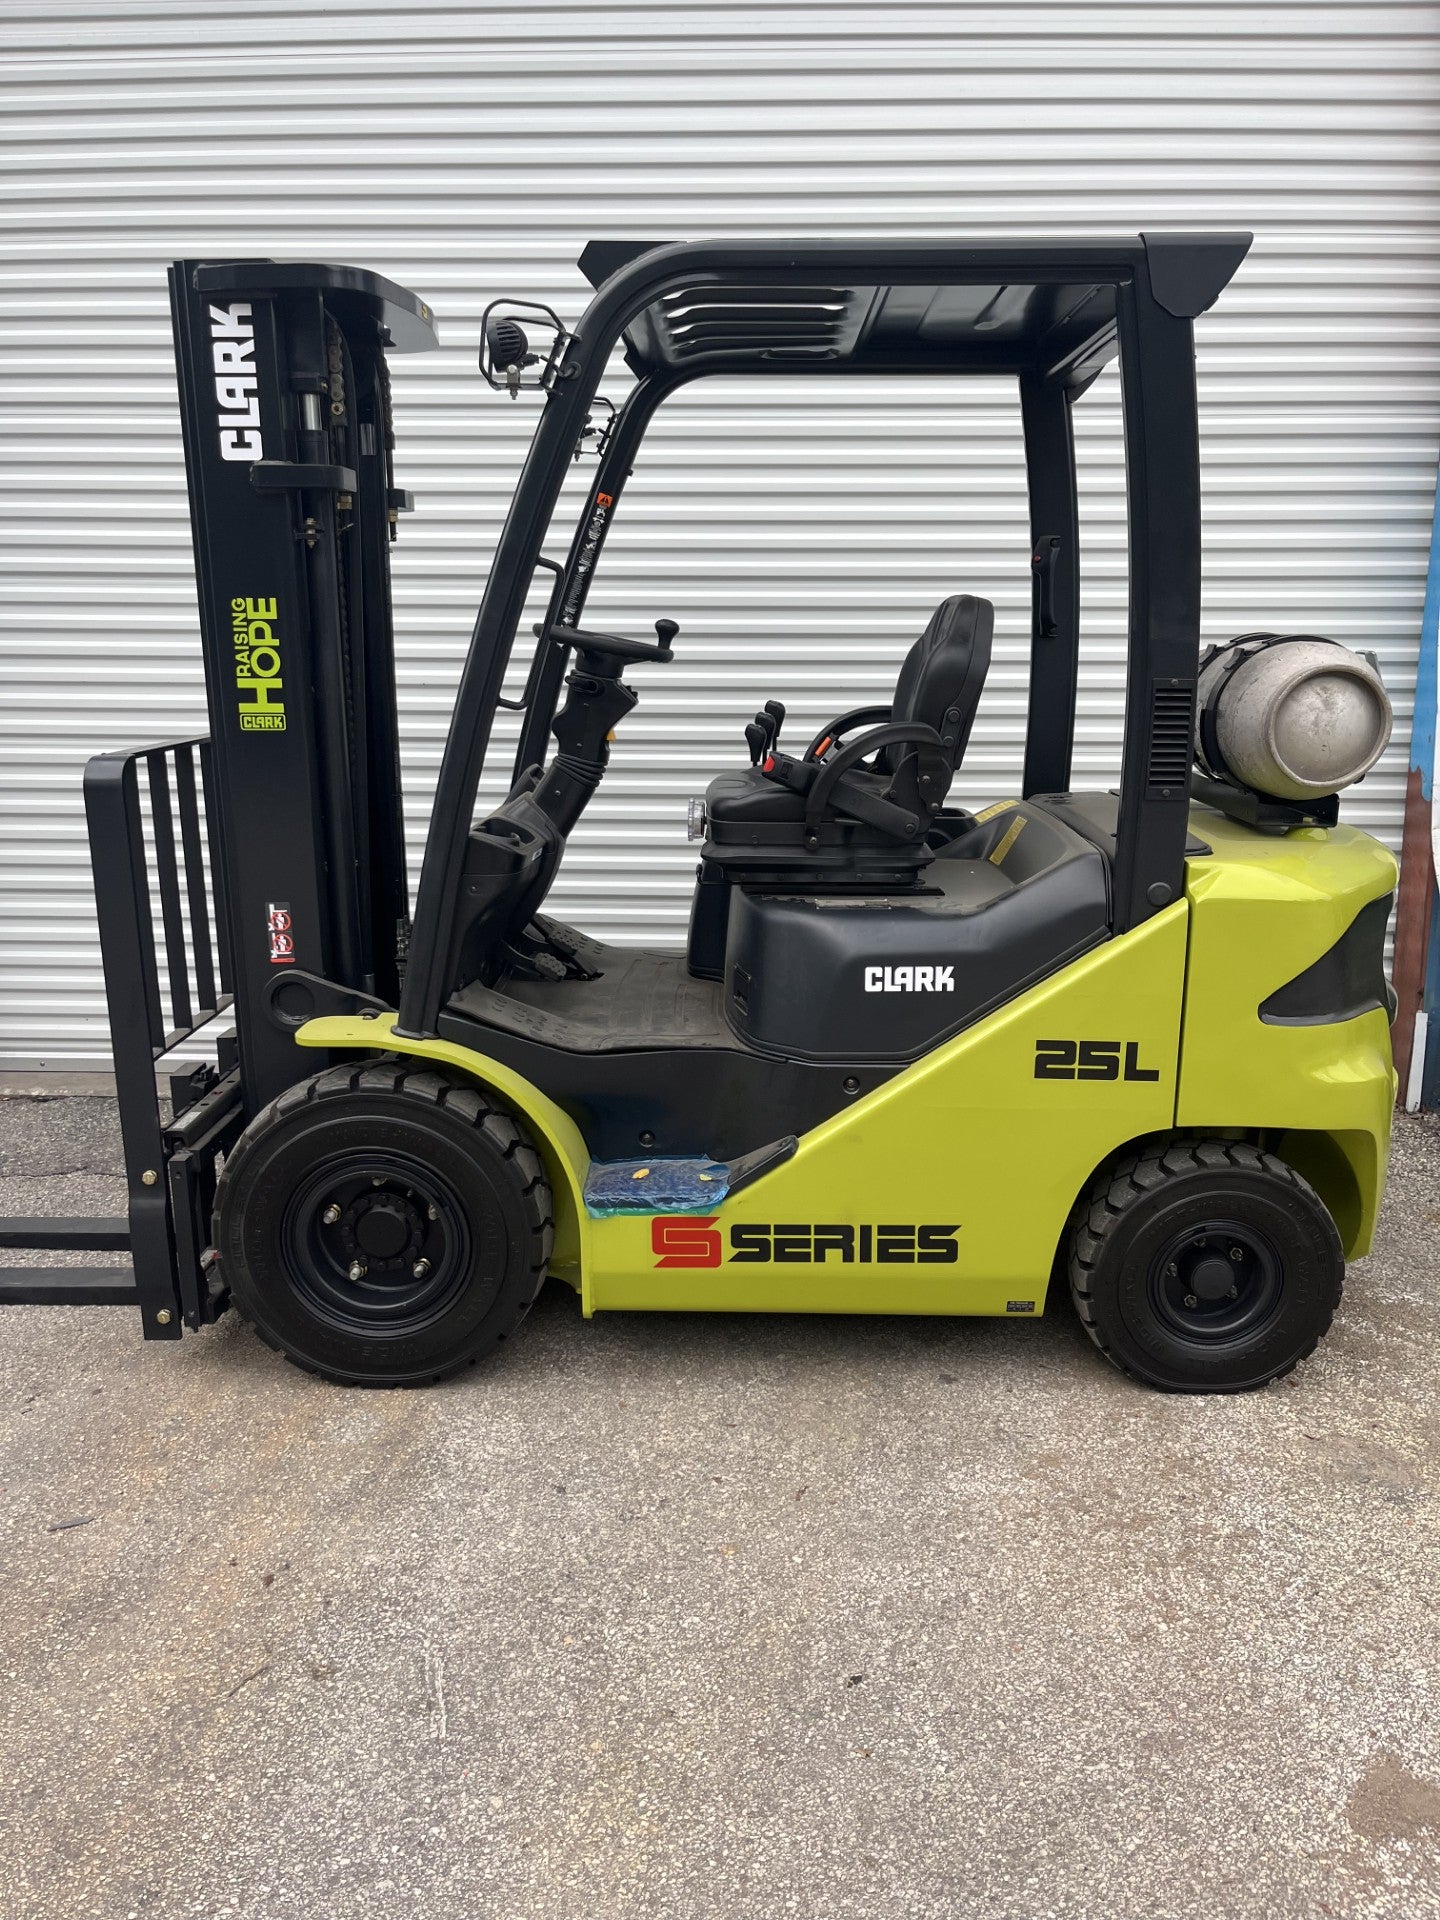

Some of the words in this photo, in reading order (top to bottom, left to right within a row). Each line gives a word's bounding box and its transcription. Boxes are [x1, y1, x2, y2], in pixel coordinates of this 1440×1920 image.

[209, 303, 264, 463] CLARK
[231, 597, 251, 677] RAISING
[236, 597, 285, 714] HOPE
[242, 715, 284, 729] CLARK
[864, 965, 955, 993] CLARK
[1034, 1039, 1160, 1082] 25L
[728, 1223, 962, 1264] SERIES
